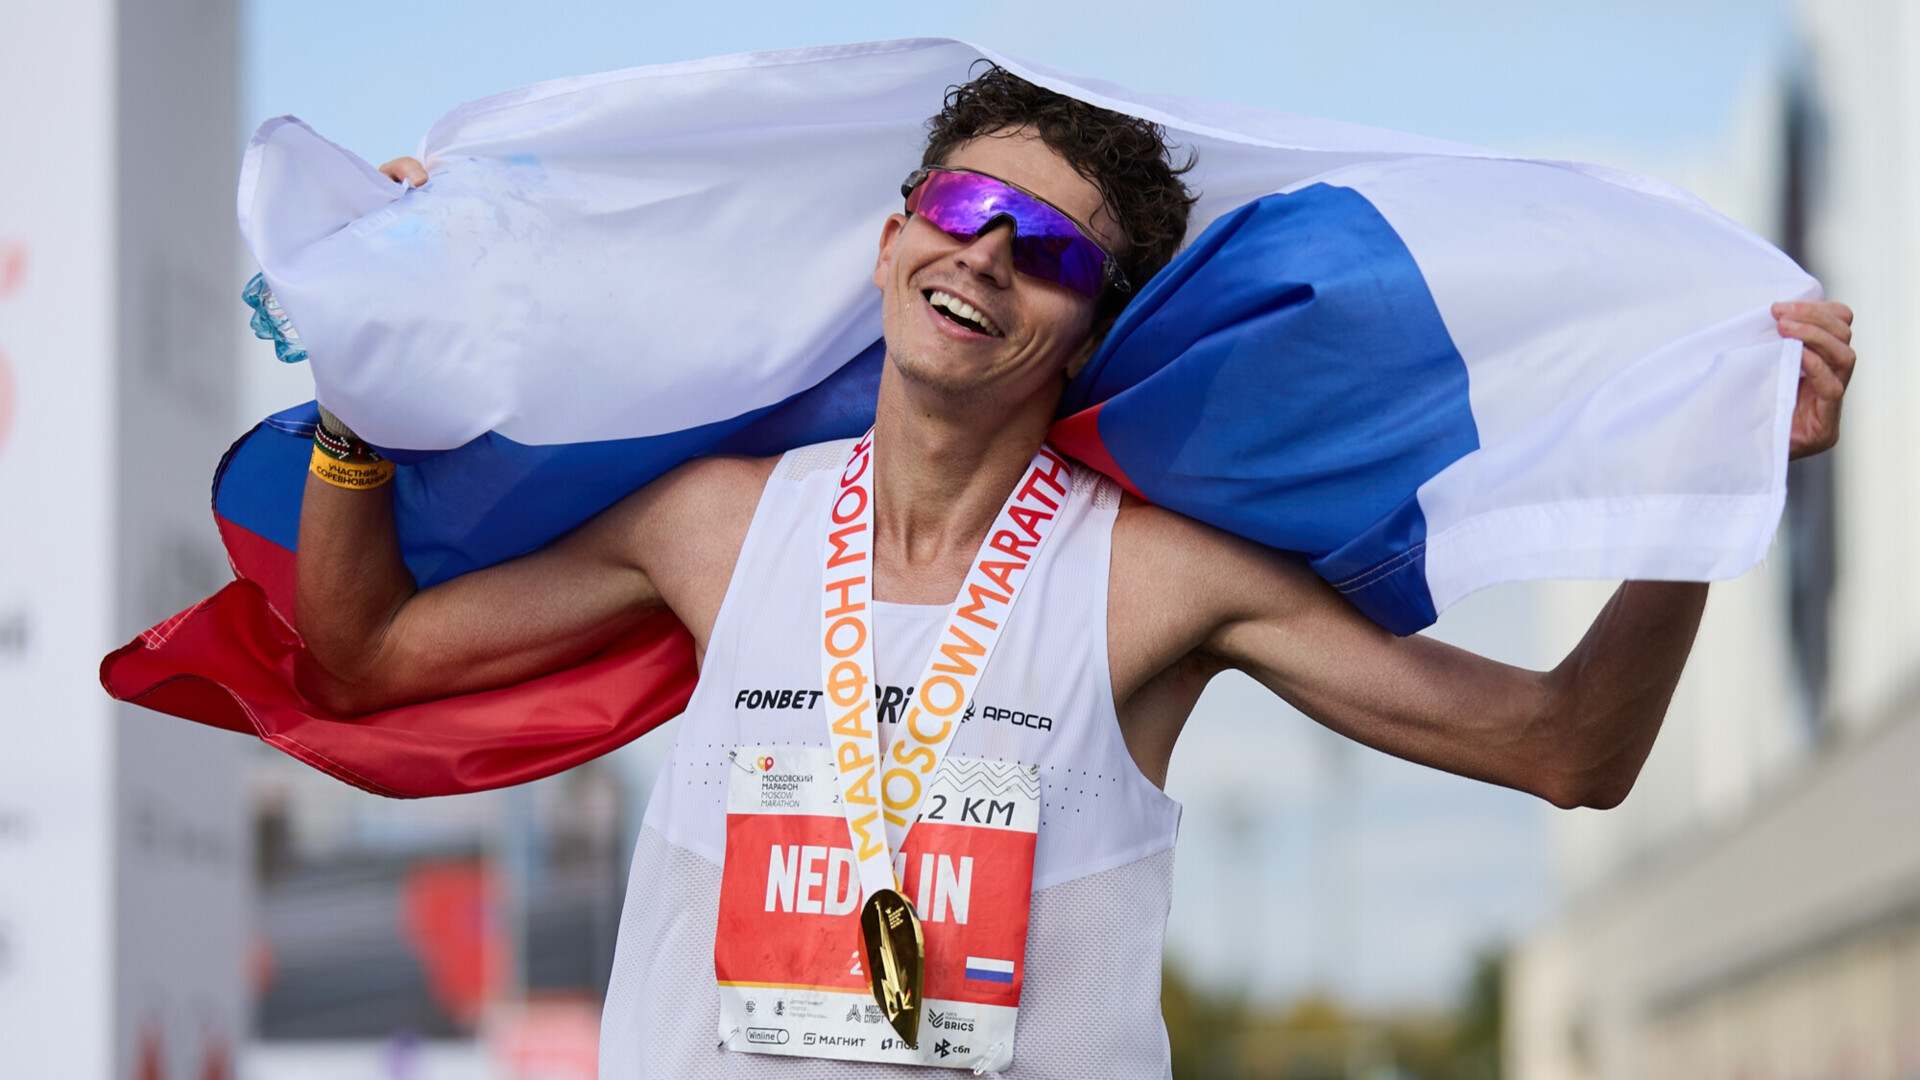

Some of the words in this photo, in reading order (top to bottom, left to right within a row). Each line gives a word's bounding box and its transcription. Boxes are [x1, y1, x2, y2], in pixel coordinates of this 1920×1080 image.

[328, 463, 379, 477] УЧАСТНИК
[735, 689, 823, 710] FONBET
[824, 575, 884, 863] МАРАФОН
[761, 773, 813, 783] МОСКОВСКИЙ
[761, 782, 798, 791] МАРАФОН
[761, 791, 793, 799] MOSCOW
[760, 799, 800, 808] MARATHON
[764, 844, 974, 925] NEDIN
[944, 1020, 975, 1032] BRICS
[748, 1030, 775, 1041] Winline
[819, 1035, 866, 1047] МАГНИТ
